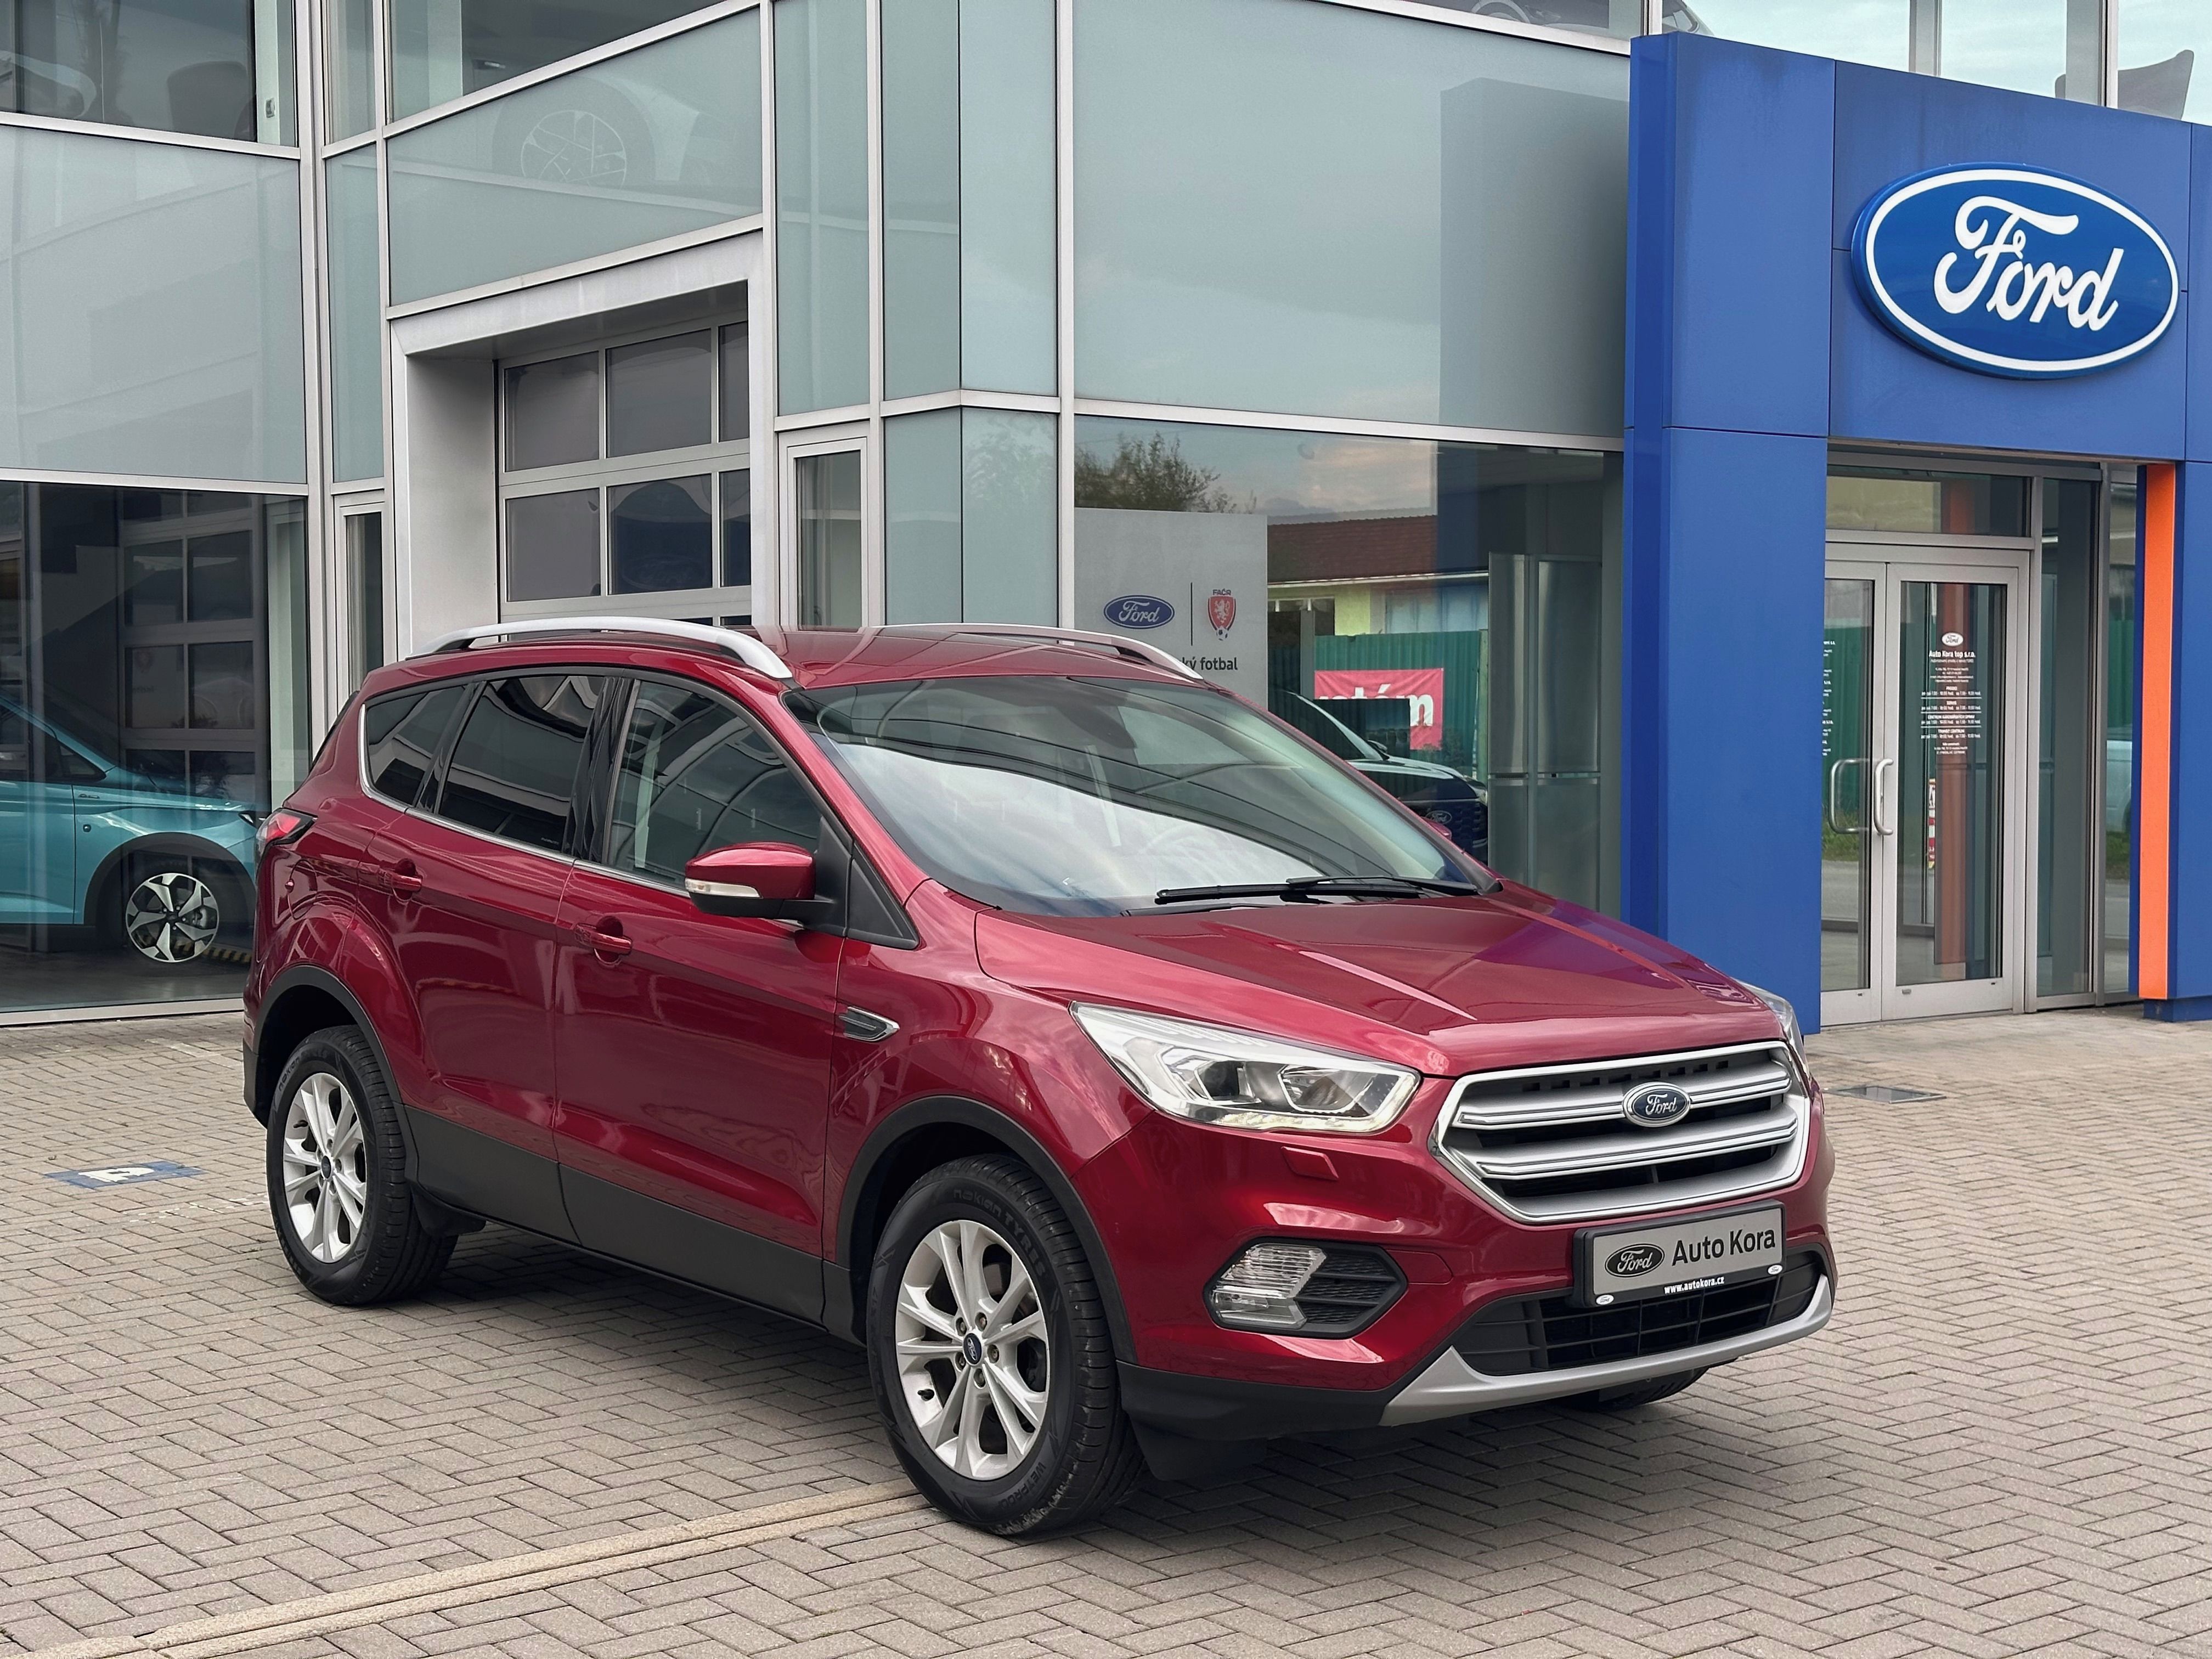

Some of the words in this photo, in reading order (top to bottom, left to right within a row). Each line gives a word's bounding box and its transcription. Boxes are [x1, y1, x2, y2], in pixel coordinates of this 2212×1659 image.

[1933, 195, 2124, 331] Ford
[1118, 600, 1160, 623] Ford
[1200, 657, 1238, 670] fotbal
[1954, 651, 1963, 659] top
[1645, 1093, 1678, 1116] Ford
[1617, 1248, 1652, 1273] Ford
[1672, 1236, 1724, 1267] Auto
[1729, 1229, 1776, 1256] Kora
[1664, 1276, 1725, 1295] www.autokora.cz
